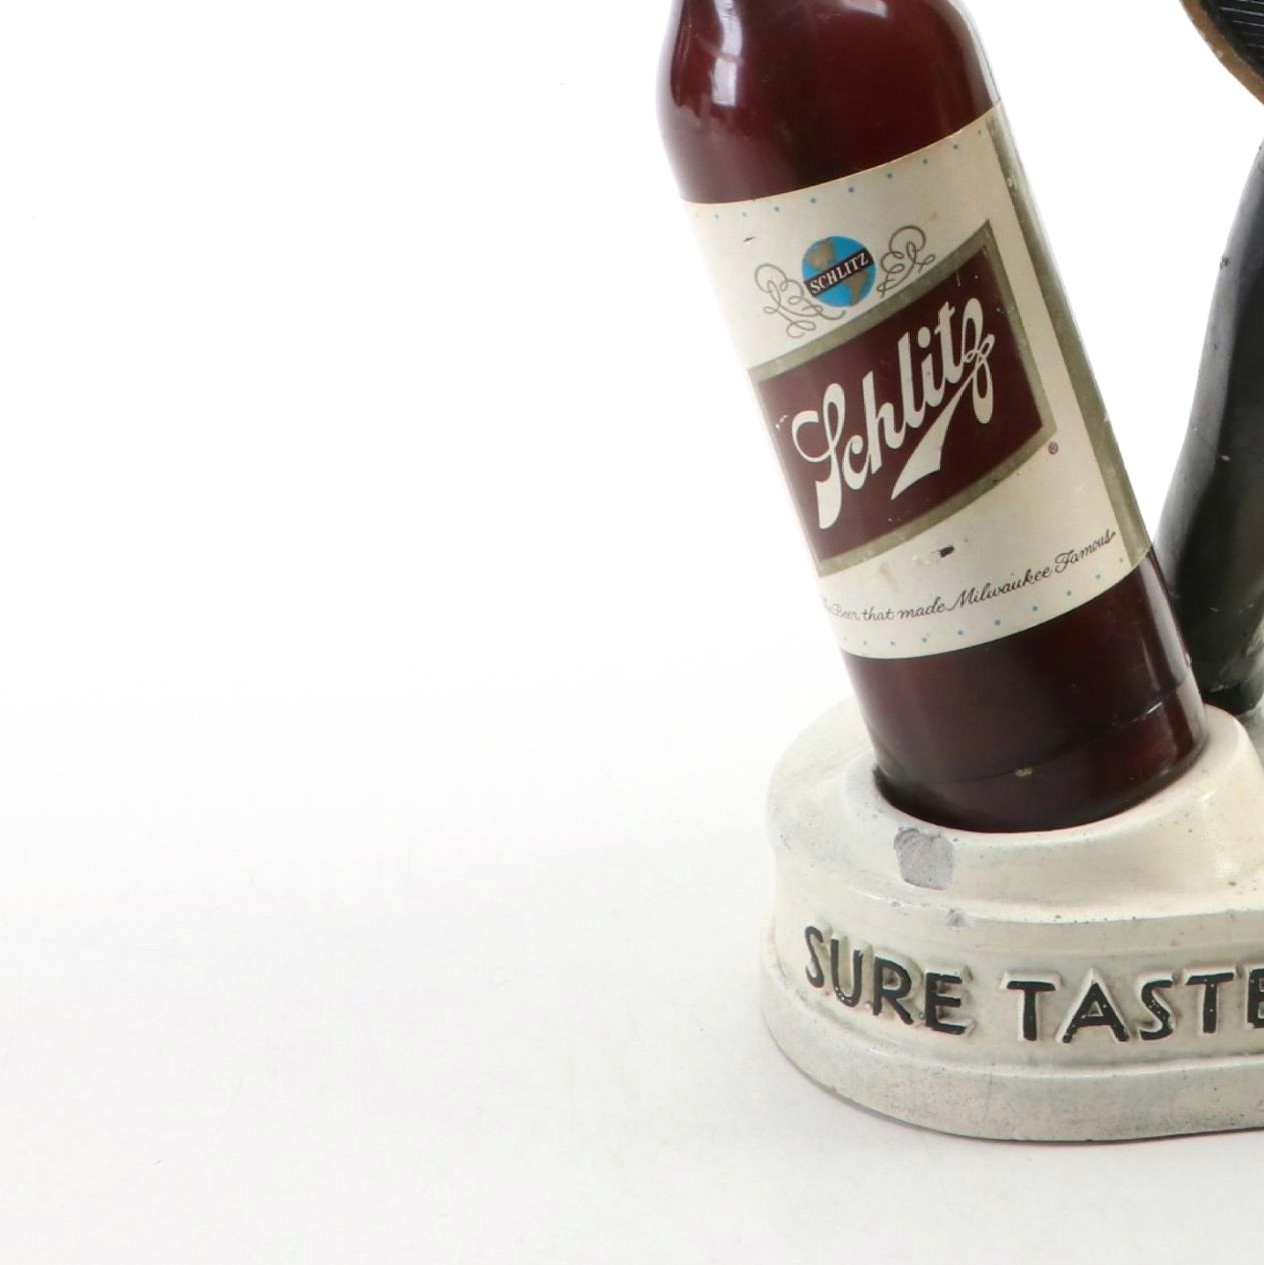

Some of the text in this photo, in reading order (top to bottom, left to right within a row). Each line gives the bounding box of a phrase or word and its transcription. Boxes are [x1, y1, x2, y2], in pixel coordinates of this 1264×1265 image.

[809, 250, 870, 294] SCHLITZ
[791, 297, 997, 530] Schlitz
[862, 605, 895, 621] that
[900, 598, 946, 620] made
[947, 565, 1051, 612] Milwaukee
[1054, 528, 1117, 573] Famous
[804, 925, 968, 1035] SURE
